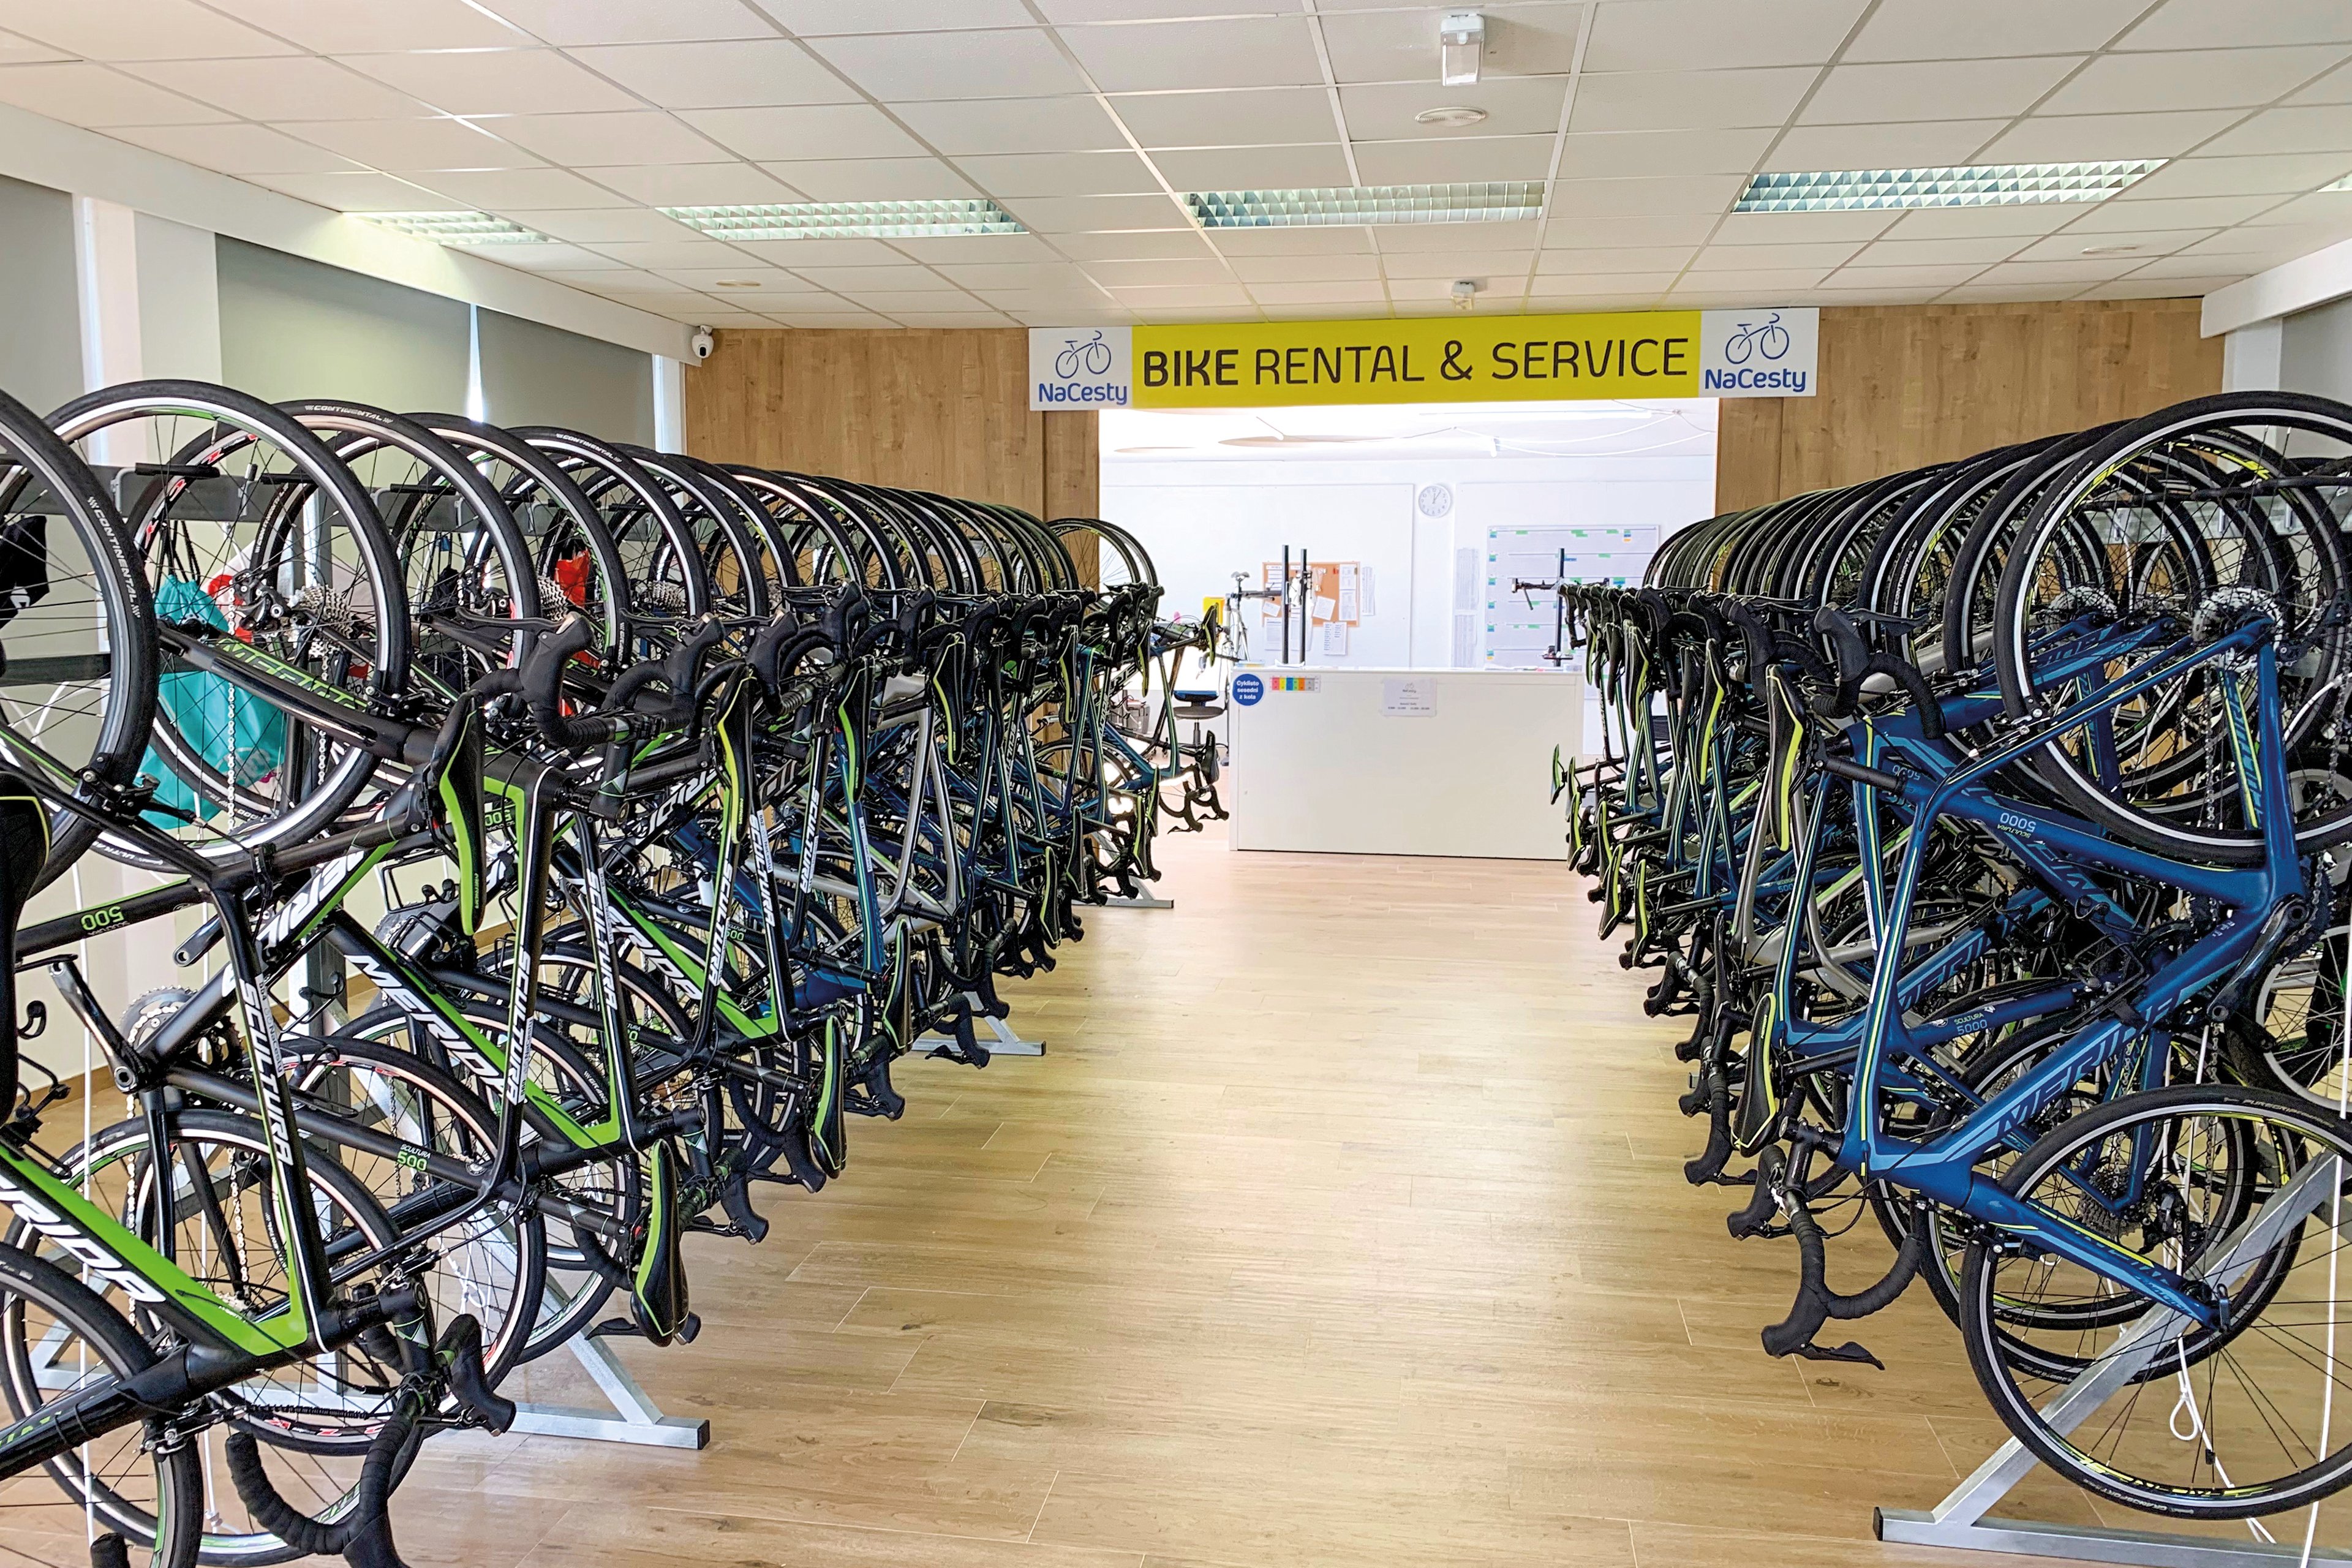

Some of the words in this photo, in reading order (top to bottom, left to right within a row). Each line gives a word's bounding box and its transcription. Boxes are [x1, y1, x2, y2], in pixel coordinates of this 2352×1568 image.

[1144, 349, 1239, 387] BIKE
[1255, 345, 1425, 385] RENTAL
[1440, 339, 1473, 381] &
[1491, 337, 1689, 380] SERVICE
[1705, 368, 1806, 393] NaCesty
[1038, 383, 1128, 405] NaCesty
[313, 404, 382, 421] CONTINENTAL
[564, 435, 614, 459] CONTINENTAL
[94, 508, 137, 603] CONTINENTAL
[1894, 546, 1916, 606] CONTINENTAL
[1997, 823, 2032, 839] SCULTURA
[1999, 812, 2037, 833] 5000
[800, 786, 820, 894] SCULTURA
[749, 814, 776, 927] SCULTURA
[81, 906, 124, 931] 500
[709, 858, 734, 986] SCULTURA
[587, 869, 617, 1010] SCULTURA
[506, 946, 531, 1105] SCULTURA
[1954, 1012, 1985, 1025] SCULTURA
[1957, 1019, 1988, 1035] 5000
[269, 1026, 282, 1072] NaCesty
[239, 978, 293, 1166] SCULTURA
[397, 1150, 428, 1171] 500
[400, 1144, 431, 1159] SCULTURA
